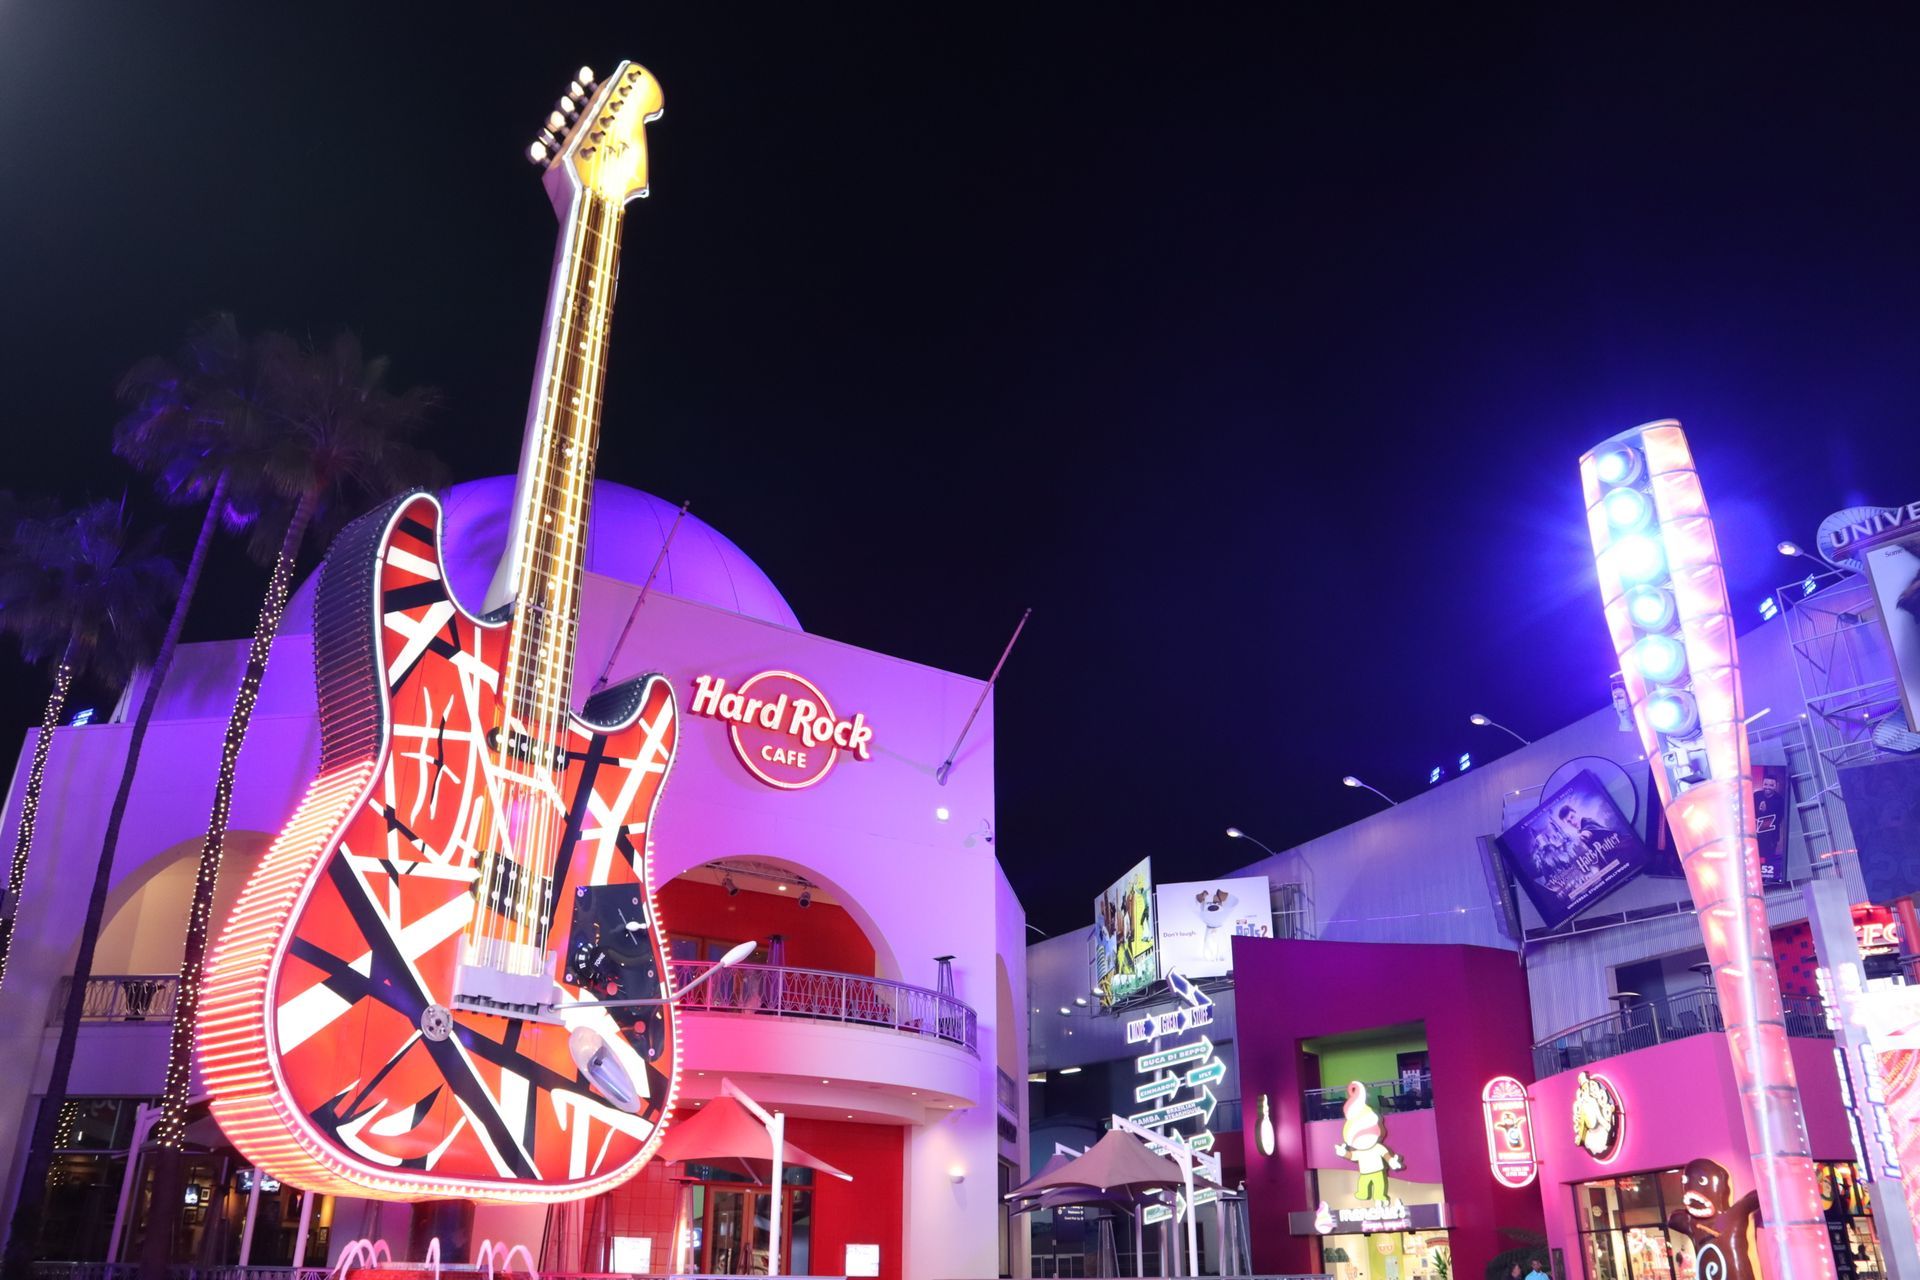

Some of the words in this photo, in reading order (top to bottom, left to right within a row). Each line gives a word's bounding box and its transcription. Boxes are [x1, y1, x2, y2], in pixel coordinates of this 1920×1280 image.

[691, 674, 788, 731] Hard
[787, 697, 874, 760] Rock
[761, 744, 808, 769] CAFE
[1576, 848, 1599, 873] Harry
[1592, 833, 1620, 864] Potter
[1143, 1057, 1166, 1067] BUCA
[1180, 1046, 1206, 1058] BEPPO
[1166, 1102, 1196, 1114] BRAZILIAN
